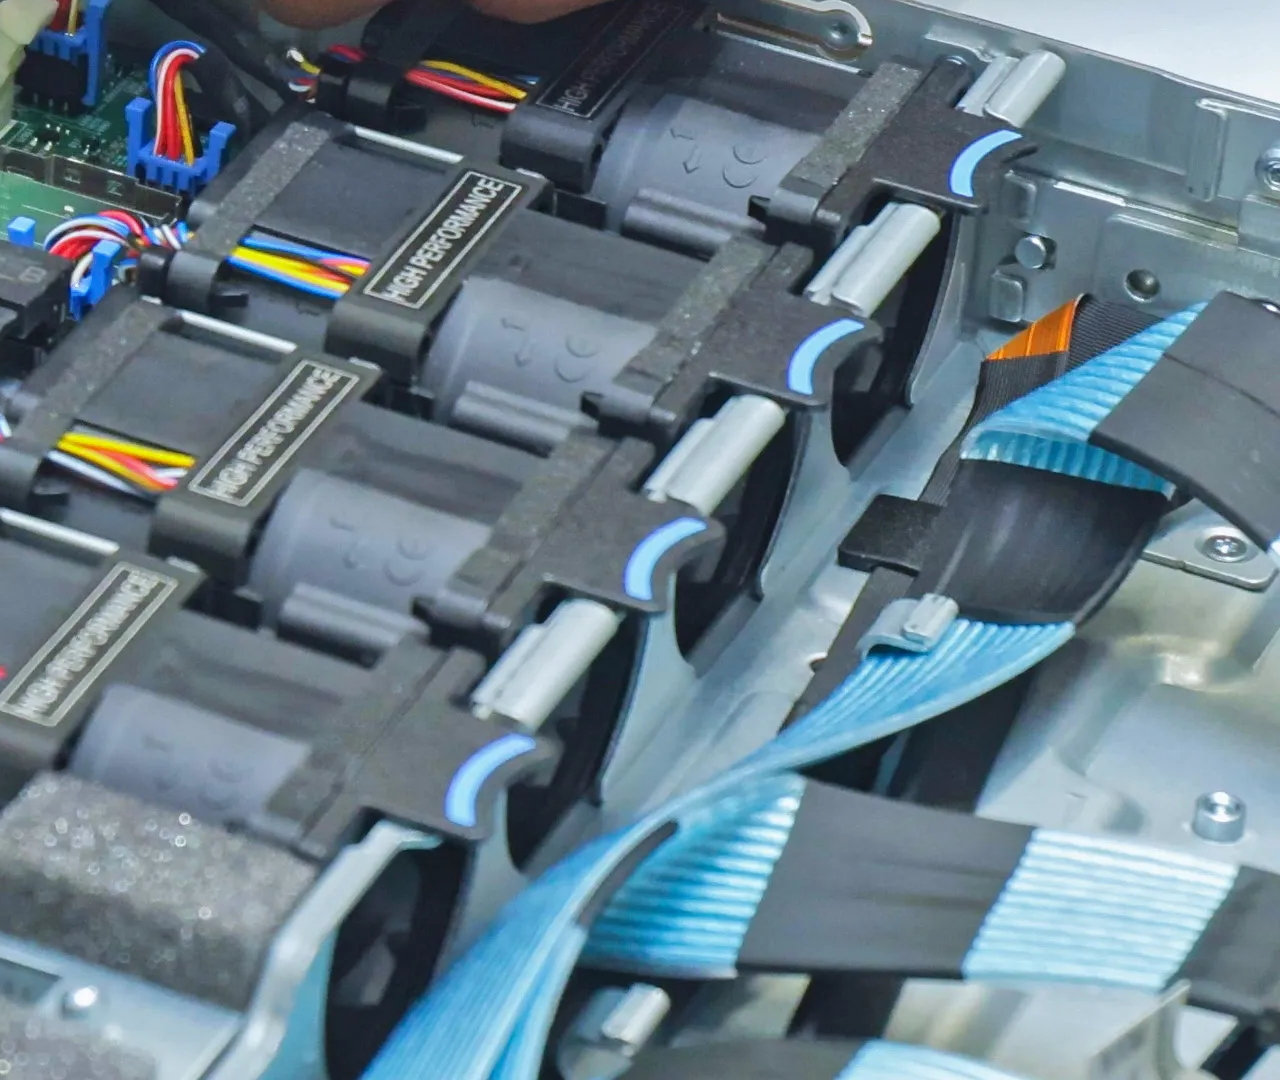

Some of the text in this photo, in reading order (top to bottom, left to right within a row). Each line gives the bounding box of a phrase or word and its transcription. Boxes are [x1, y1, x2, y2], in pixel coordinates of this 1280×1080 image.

[555, 80, 590, 113] HIGH
[381, 178, 505, 301] HIGH PERFORMANCE
[208, 368, 342, 498] HIGH PERFORMANCE
[16, 569, 162, 717] HIGH PERFORMANCE
